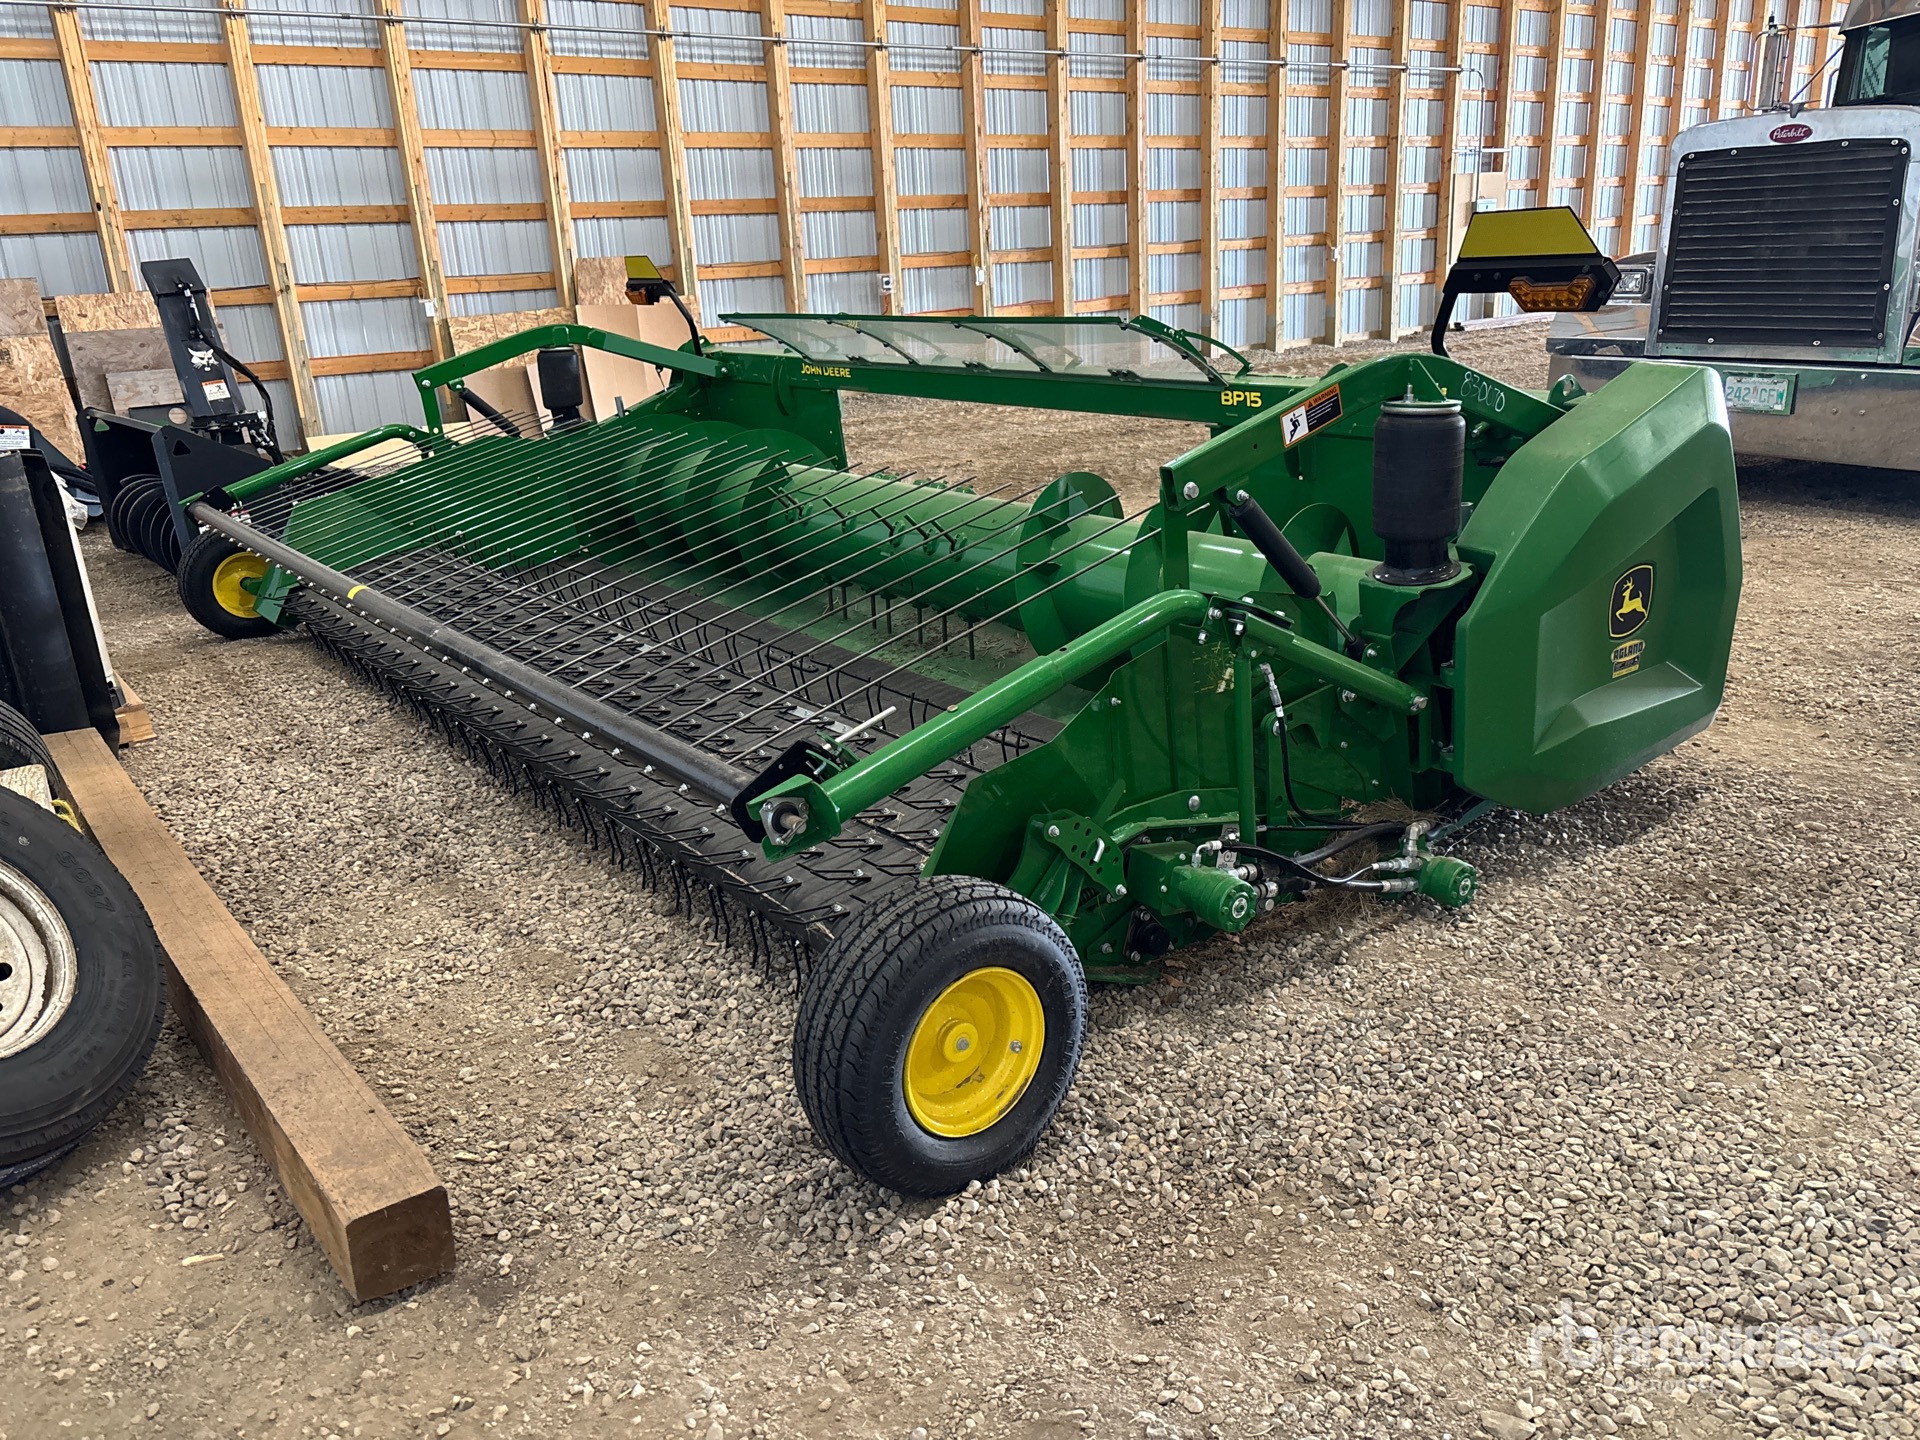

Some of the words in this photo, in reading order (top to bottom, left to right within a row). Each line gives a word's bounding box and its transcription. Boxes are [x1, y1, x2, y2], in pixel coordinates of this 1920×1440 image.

[1773, 127, 1808, 139] Peterbilt
[801, 363, 822, 376] JOHN
[823, 367, 851, 378] DEERE
[1221, 390, 1262, 408] BP15
[1312, 386, 1338, 405] WARNING
[1725, 386, 1751, 403] 242
[1050, 959, 1077, 1019] SPORT
